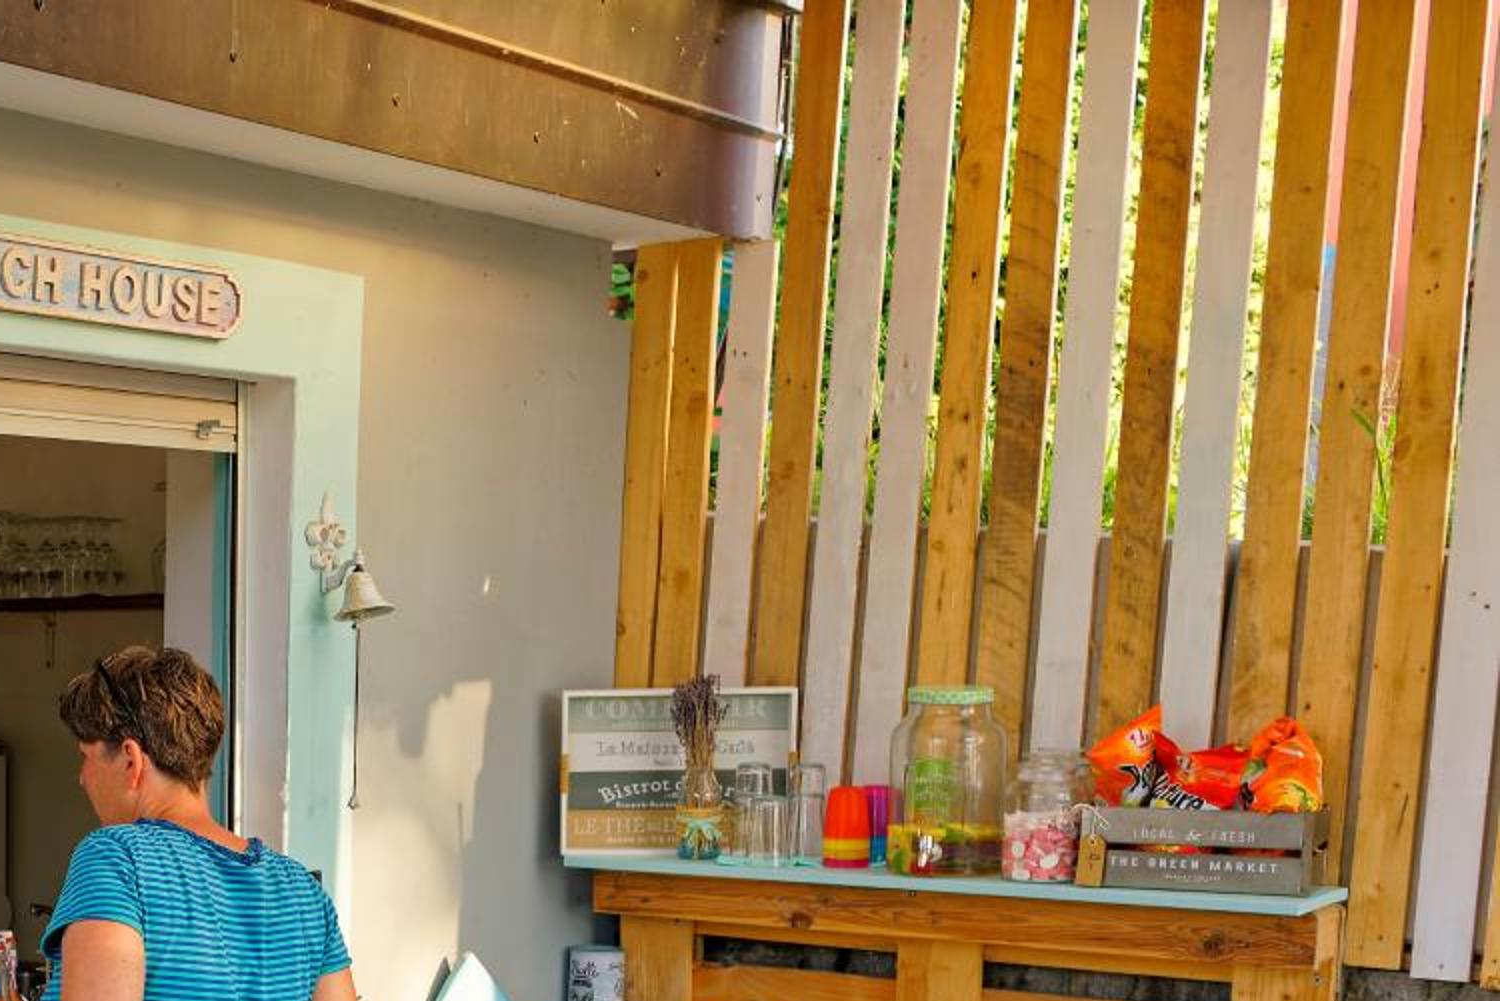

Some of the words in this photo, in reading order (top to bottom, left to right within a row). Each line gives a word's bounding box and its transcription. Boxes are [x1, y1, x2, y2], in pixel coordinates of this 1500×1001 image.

[78, 261, 224, 328] HOUSE
[597, 780, 670, 803] Bistrot
[1186, 829, 1204, 842] &
[1211, 831, 1256, 843] FRESH
[1109, 856, 1139, 868] THE
[1148, 857, 1201, 870] GREEN
[1209, 861, 1280, 875] MARKET
